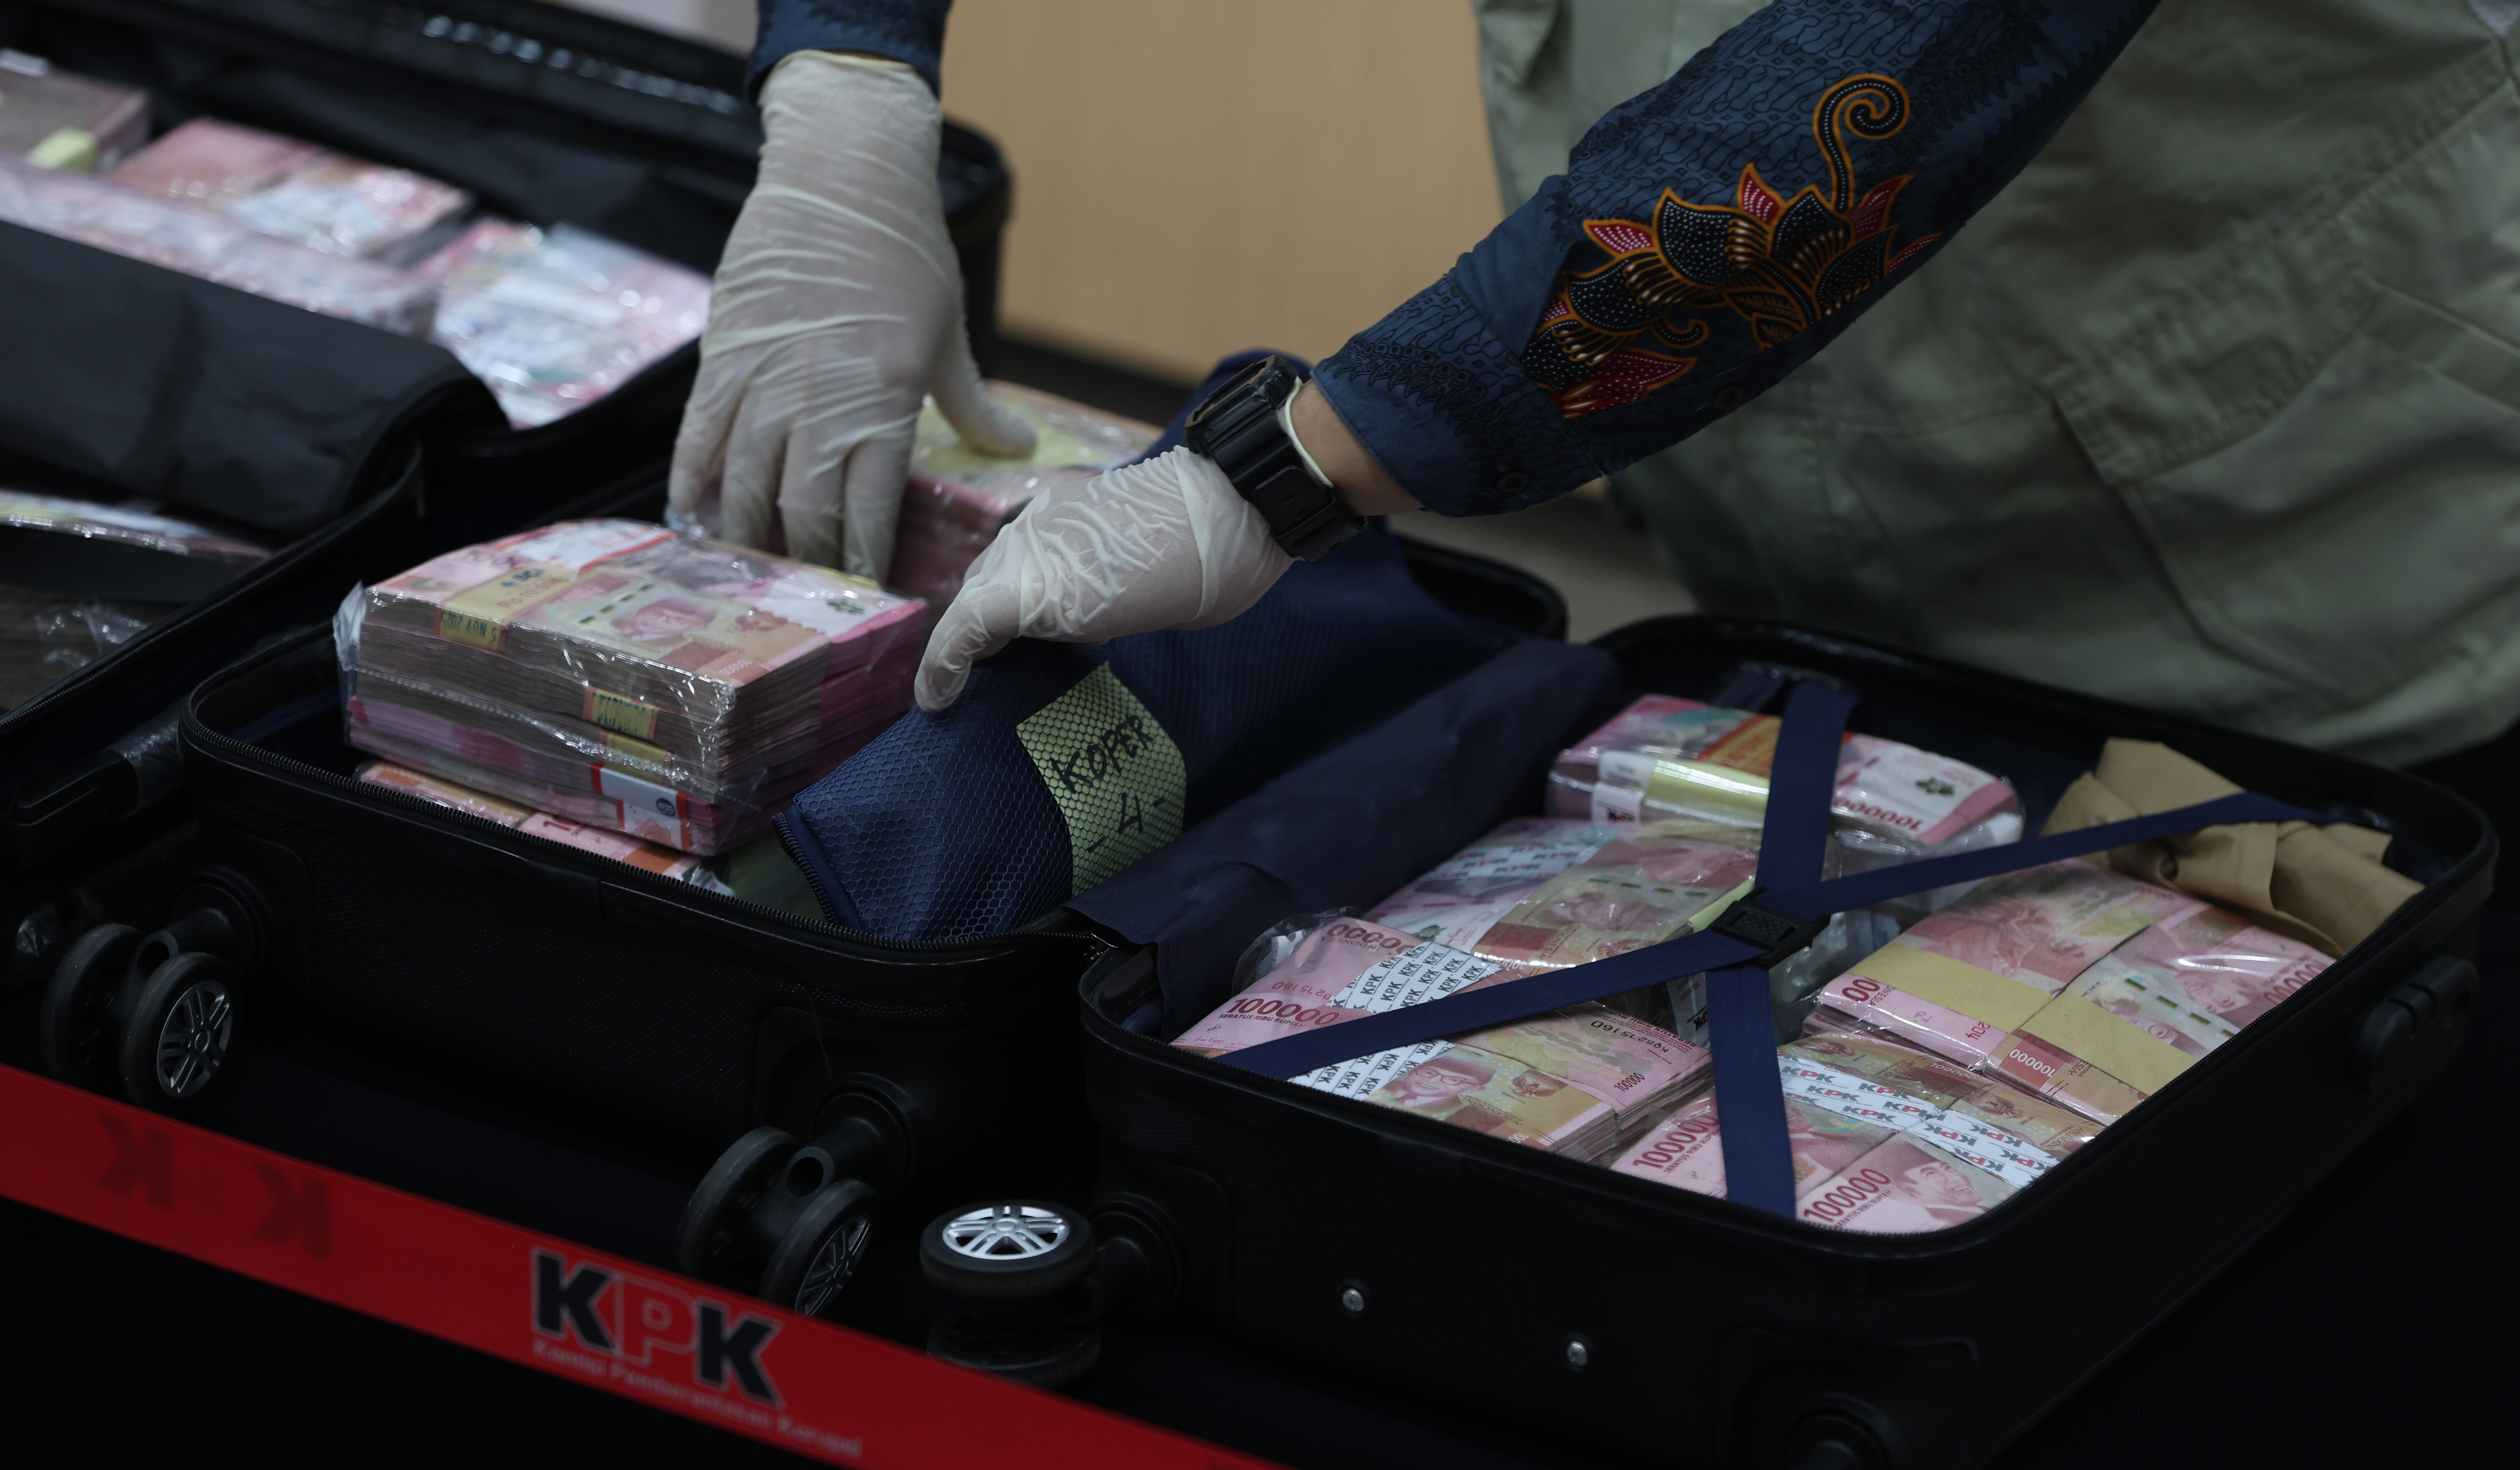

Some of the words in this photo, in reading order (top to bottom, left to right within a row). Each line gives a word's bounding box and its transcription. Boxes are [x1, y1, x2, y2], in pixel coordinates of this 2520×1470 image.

[1050, 715, 1155, 793] KOPER
[1423, 951, 1444, 965] KPK
[1442, 958, 1464, 973] KPK
[1398, 962, 1420, 976] KPK
[1418, 969, 1440, 984] KPK
[1461, 966, 1483, 981] KPK
[1360, 974, 1383, 995] KPK
[1380, 981, 1403, 1001] KPK
[1438, 976, 1460, 992] KPK
[1228, 998, 1341, 1025] 100000
[1274, 1018, 1306, 1028] RUPIAH
[1377, 1053, 1400, 1071] KPK
[1930, 1063, 1977, 1080] 100000
[2010, 1049, 2056, 1078] 100000
[1318, 1065, 1341, 1084] KPK
[1338, 1071, 1360, 1090] KPK
[1614, 1072, 1645, 1092] 100000
[1782, 1066, 1836, 1083] KPK
[1358, 1077, 1381, 1096] KPK
[1806, 1085, 1862, 1102] KPK
[1858, 1083, 1910, 1100] KPK
[1785, 1092, 1820, 1105] PK
[1843, 1105, 1898, 1123] KPK
[1633, 1115, 1720, 1169] 100000
[1922, 1124, 1979, 1146] KPK
[1969, 1124, 2023, 1148] KPK
[1664, 1155, 1690, 1174] SERATUS
[1686, 1144, 1701, 1155] RIBU
[1953, 1147, 2005, 1172] KPK
[1804, 1168, 1893, 1222] 100000
[1834, 1209, 1862, 1229] SERATUS
[1859, 1200, 1873, 1214] RIBU
[1871, 1189, 1893, 1205] RUPIAH
[530, 1245, 786, 1410] KPK
